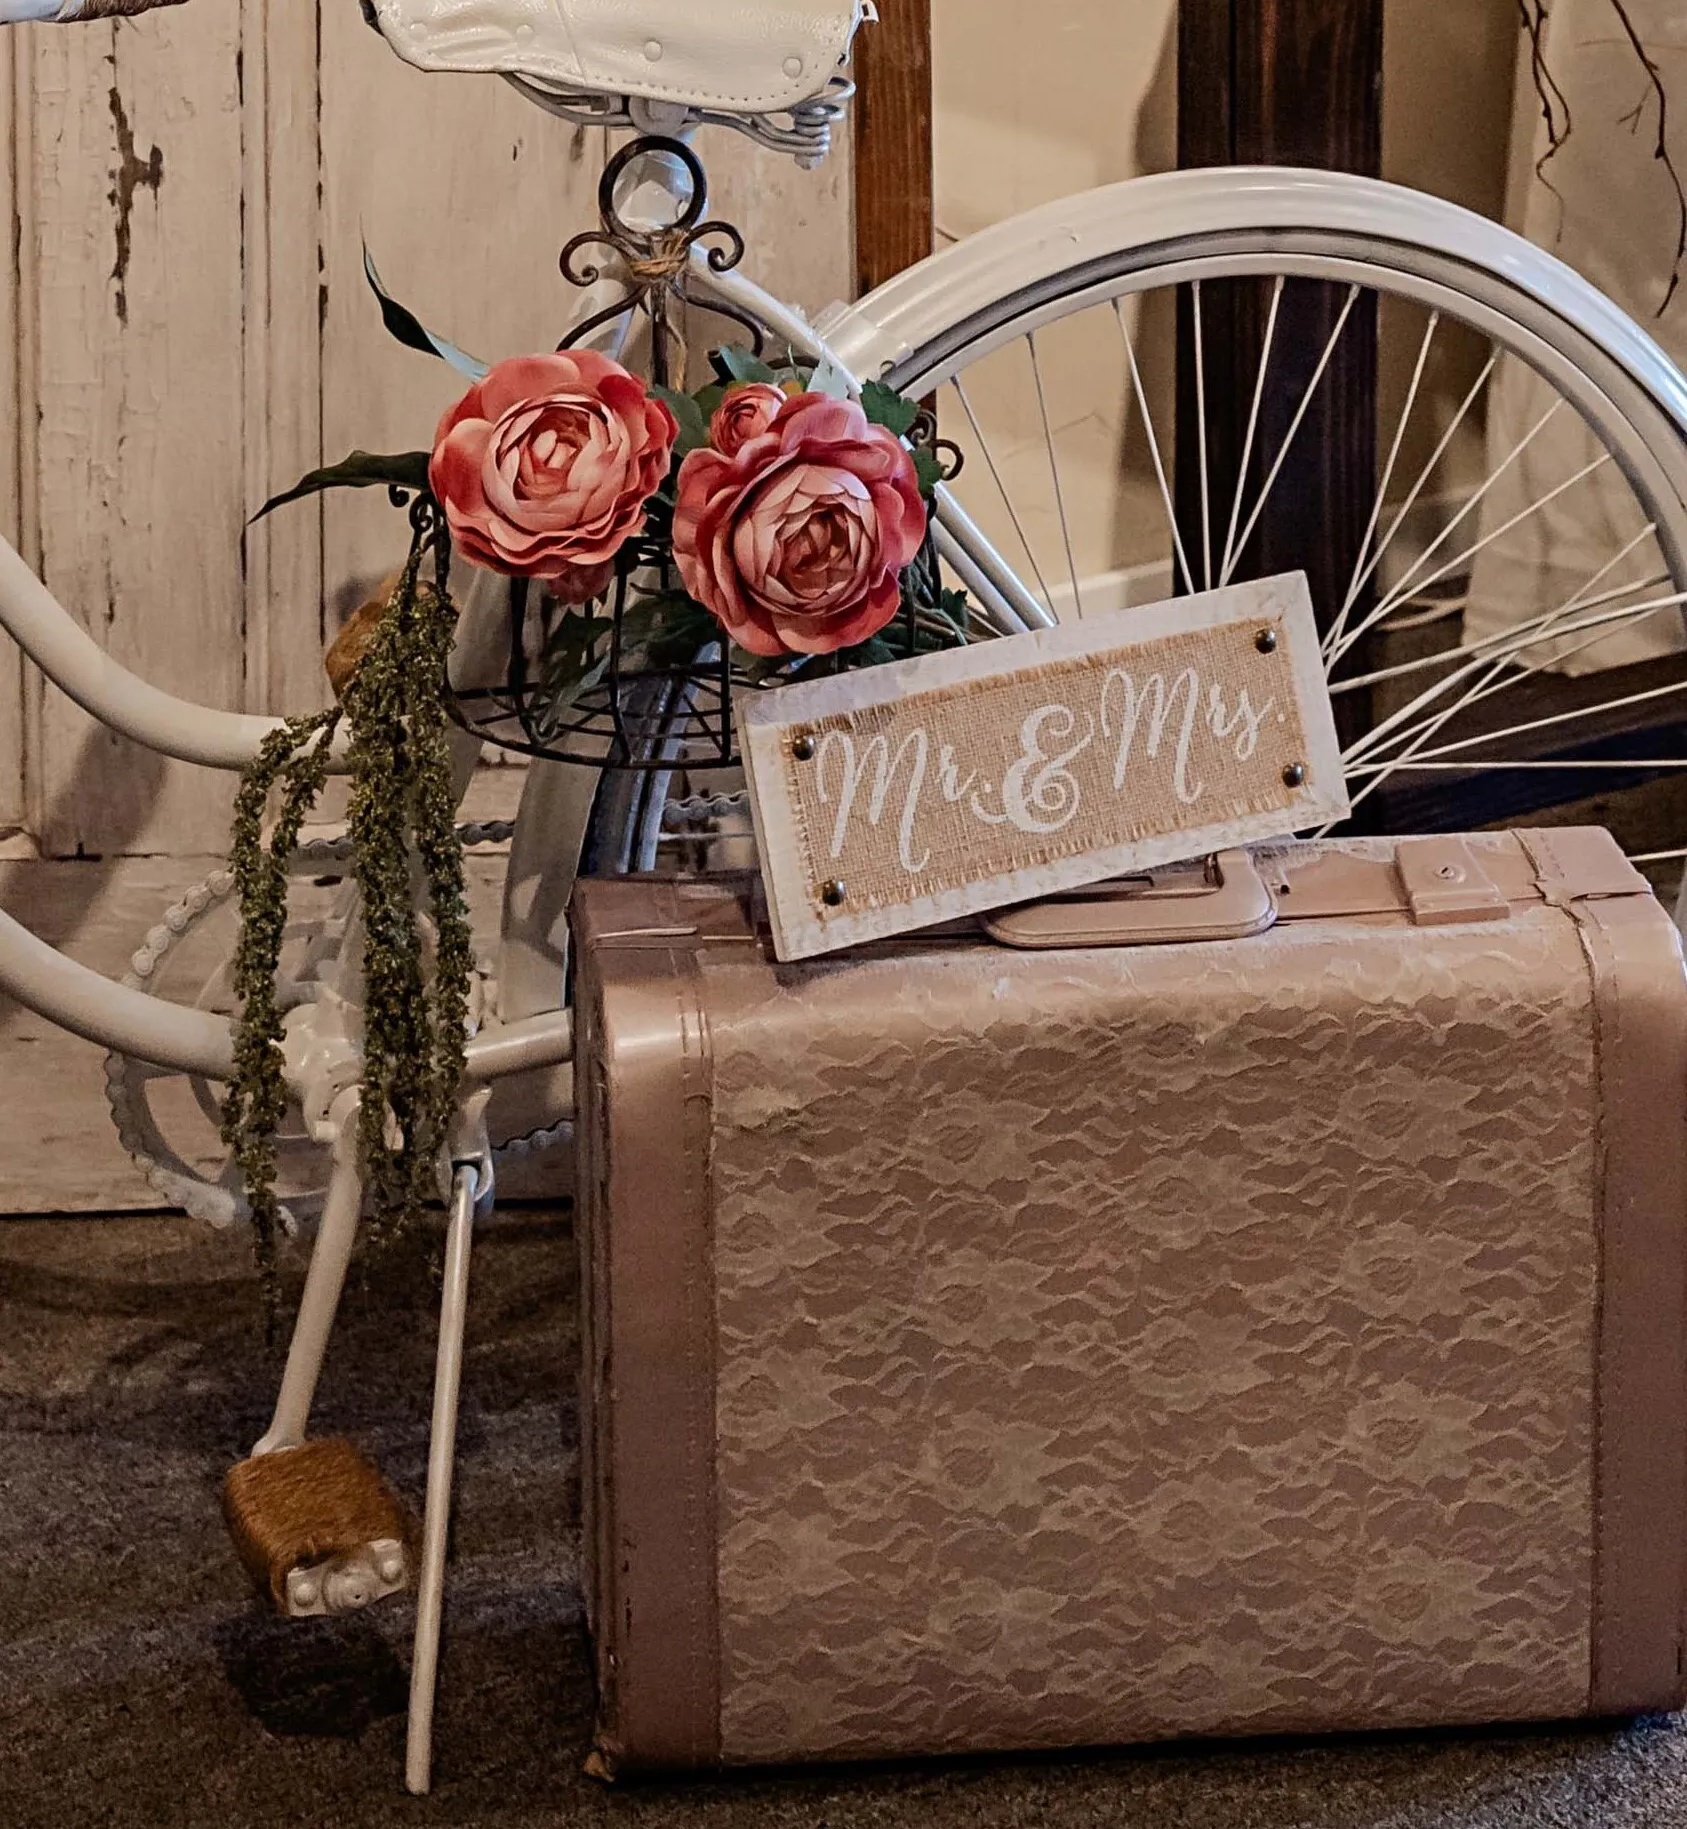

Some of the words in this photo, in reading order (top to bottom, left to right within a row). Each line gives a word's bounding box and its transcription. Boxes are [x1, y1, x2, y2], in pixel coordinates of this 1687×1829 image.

[816, 727, 991, 873] Mr.
[970, 704, 1095, 833] &
[1100, 668, 1286, 804] Mrs.
